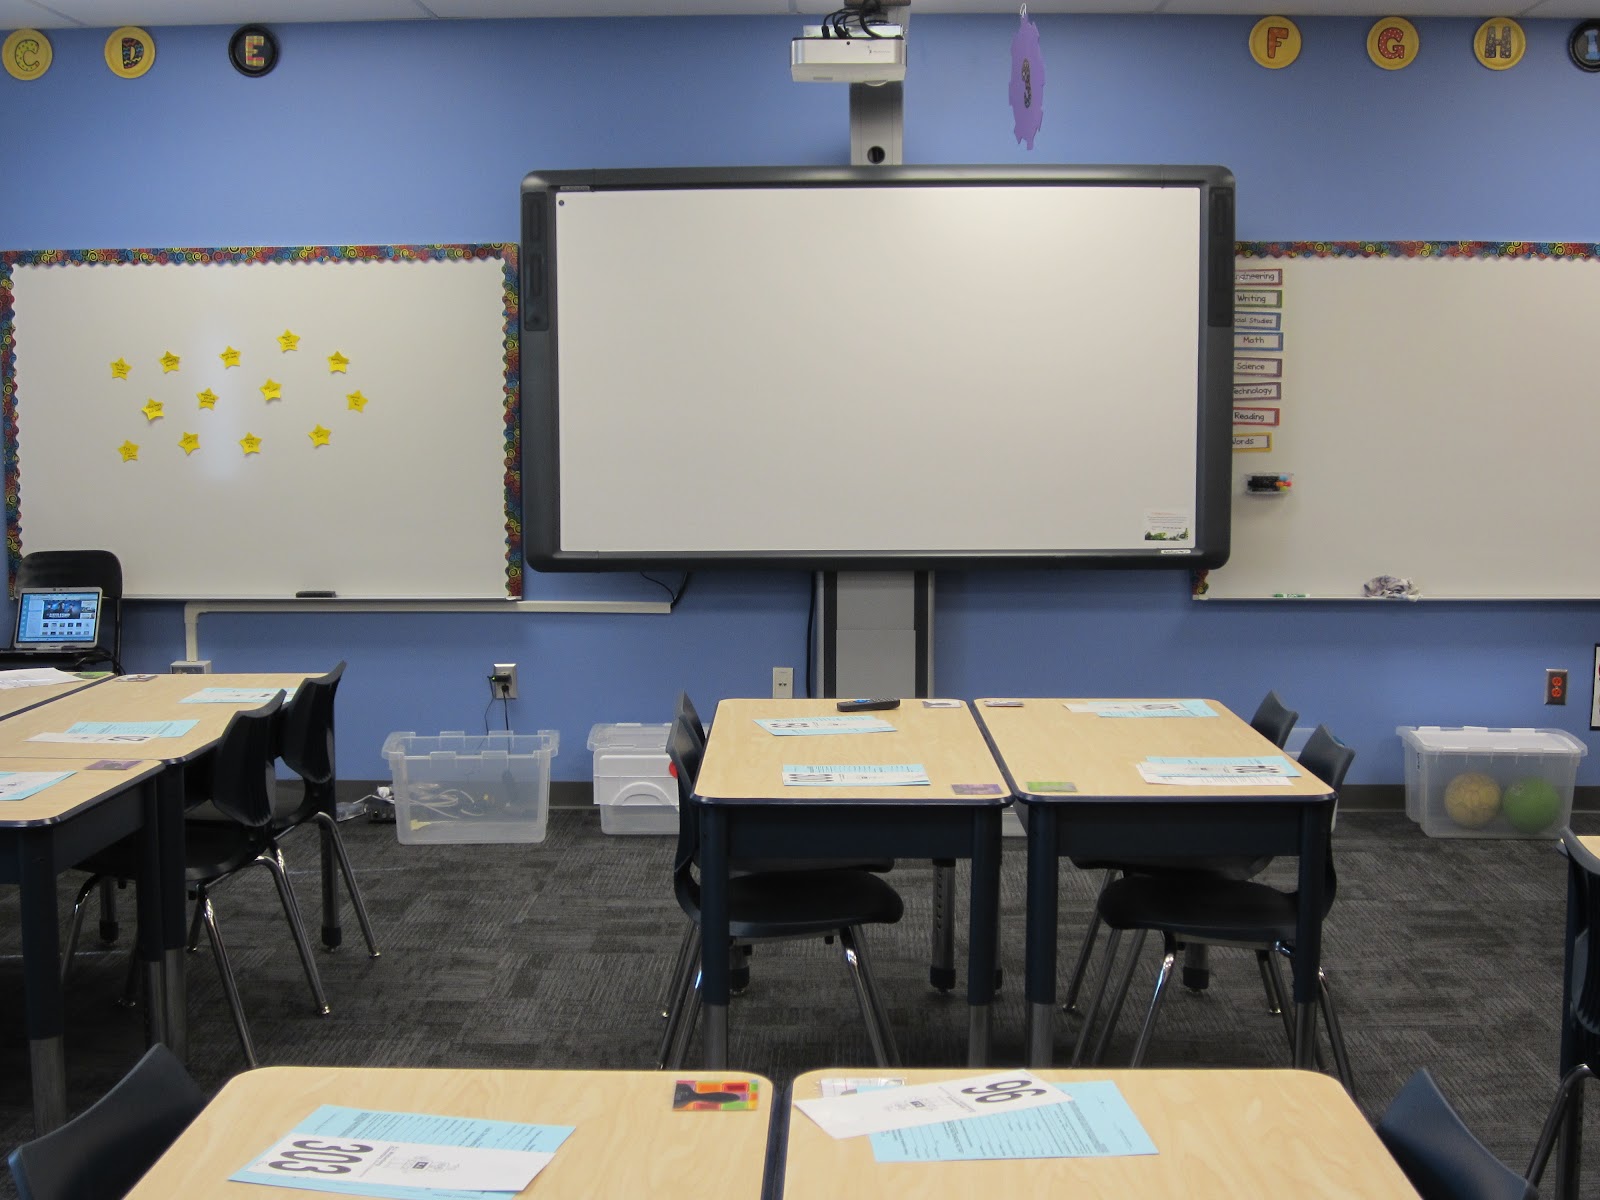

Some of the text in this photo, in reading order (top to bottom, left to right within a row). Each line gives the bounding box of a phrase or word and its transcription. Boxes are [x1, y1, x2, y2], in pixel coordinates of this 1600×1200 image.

[15, 39, 40, 72] C
[122, 37, 144, 69] D
[245, 35, 265, 67] E
[1267, 27, 1289, 59] F
[1378, 27, 1405, 60] G
[1484, 26, 1512, 59] H
[1237, 294, 1266, 304] Writing
[1243, 336, 1265, 344] Math
[1236, 362, 1265, 370] Science
[1234, 412, 1265, 422] Reading
[960, 1079, 1048, 1105] 96
[268, 1139, 374, 1175] 303
